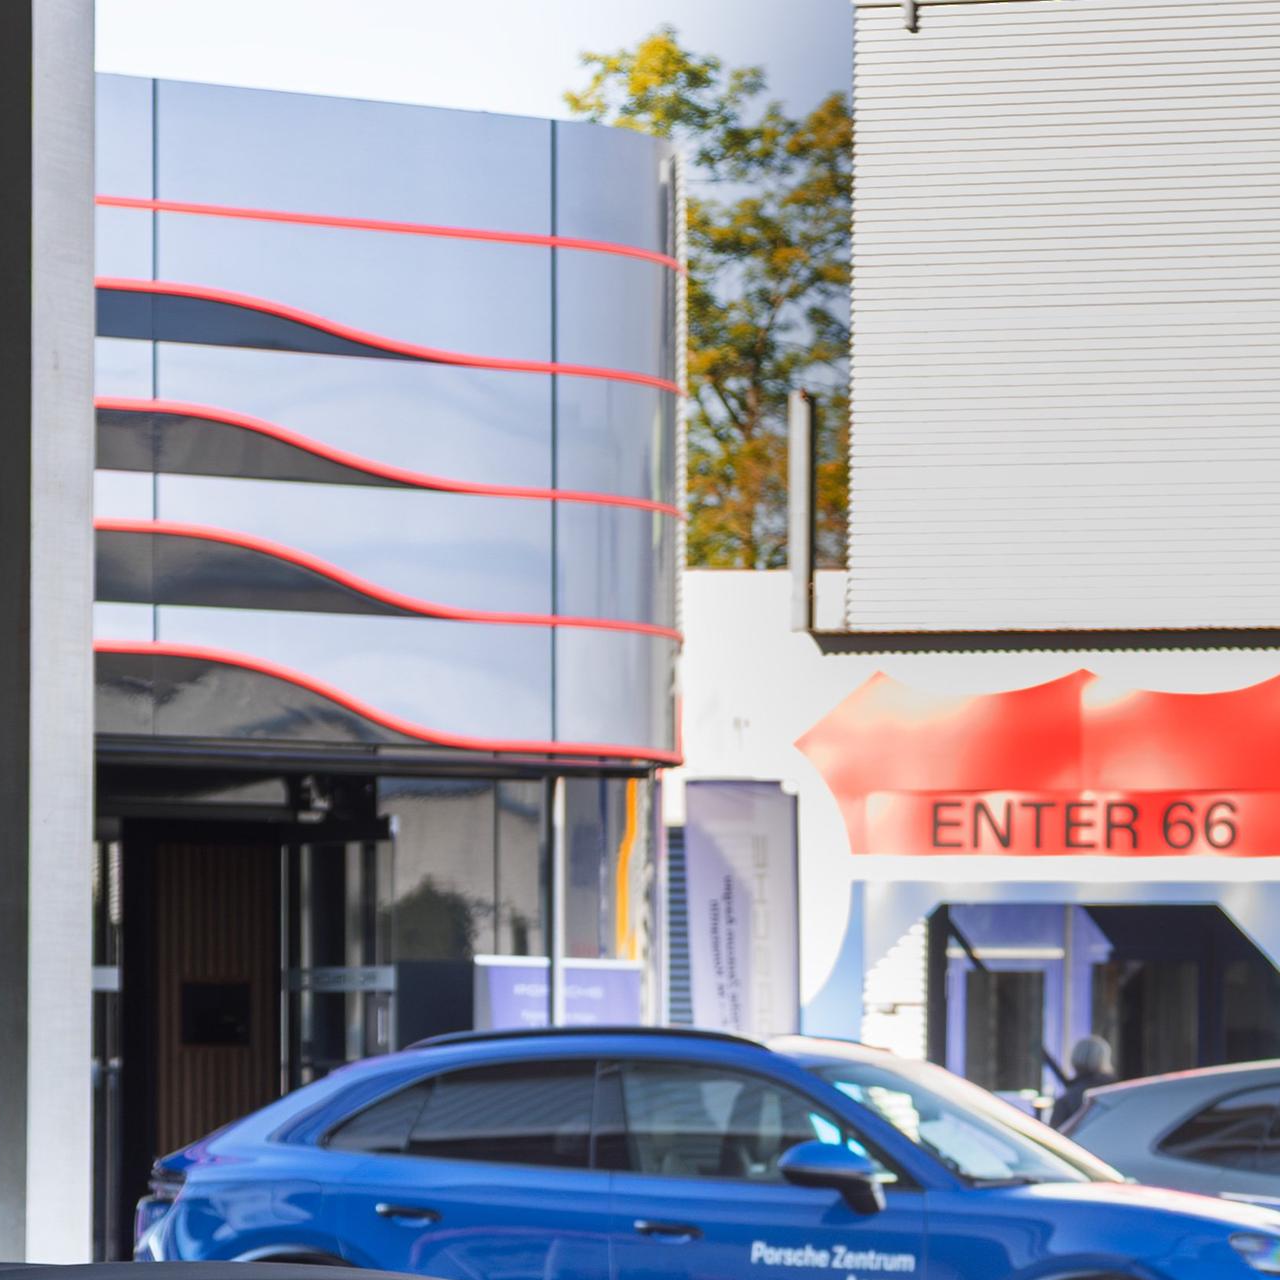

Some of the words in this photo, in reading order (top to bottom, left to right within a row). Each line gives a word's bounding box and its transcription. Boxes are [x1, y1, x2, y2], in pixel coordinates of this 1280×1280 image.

[931, 801, 1139, 849] ENTER
[1162, 801, 1238, 849] 66
[751, 1240, 830, 1268] Porsche
[831, 1245, 915, 1272] Zentrum
